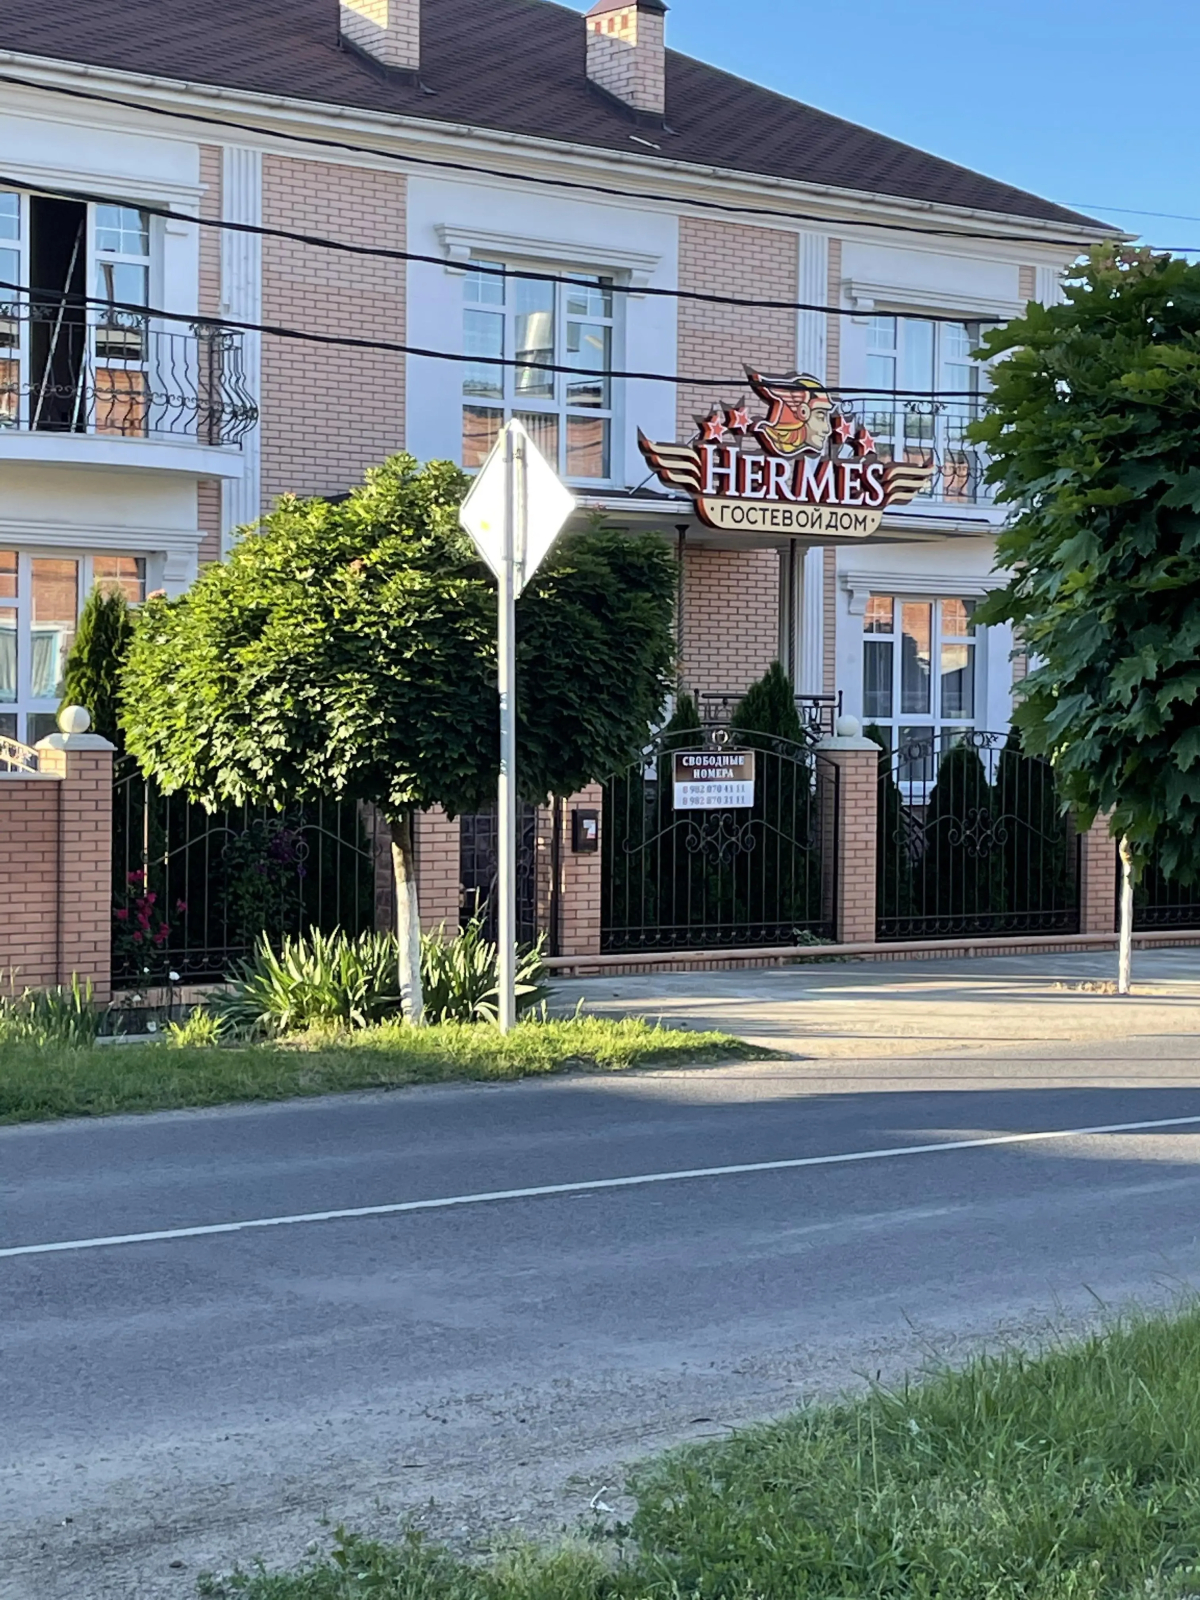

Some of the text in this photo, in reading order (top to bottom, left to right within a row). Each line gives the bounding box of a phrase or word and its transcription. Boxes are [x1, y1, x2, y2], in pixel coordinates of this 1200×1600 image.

[702, 444, 885, 507] HERMES
[720, 505, 867, 532] ГОСТЕВОЙ ДОМ
[682, 755, 745, 767] СВОБОДНЫЕ
[693, 769, 734, 779] НОМЕРА
[736, 784, 745, 793] 11
[736, 796, 745, 804] 11
